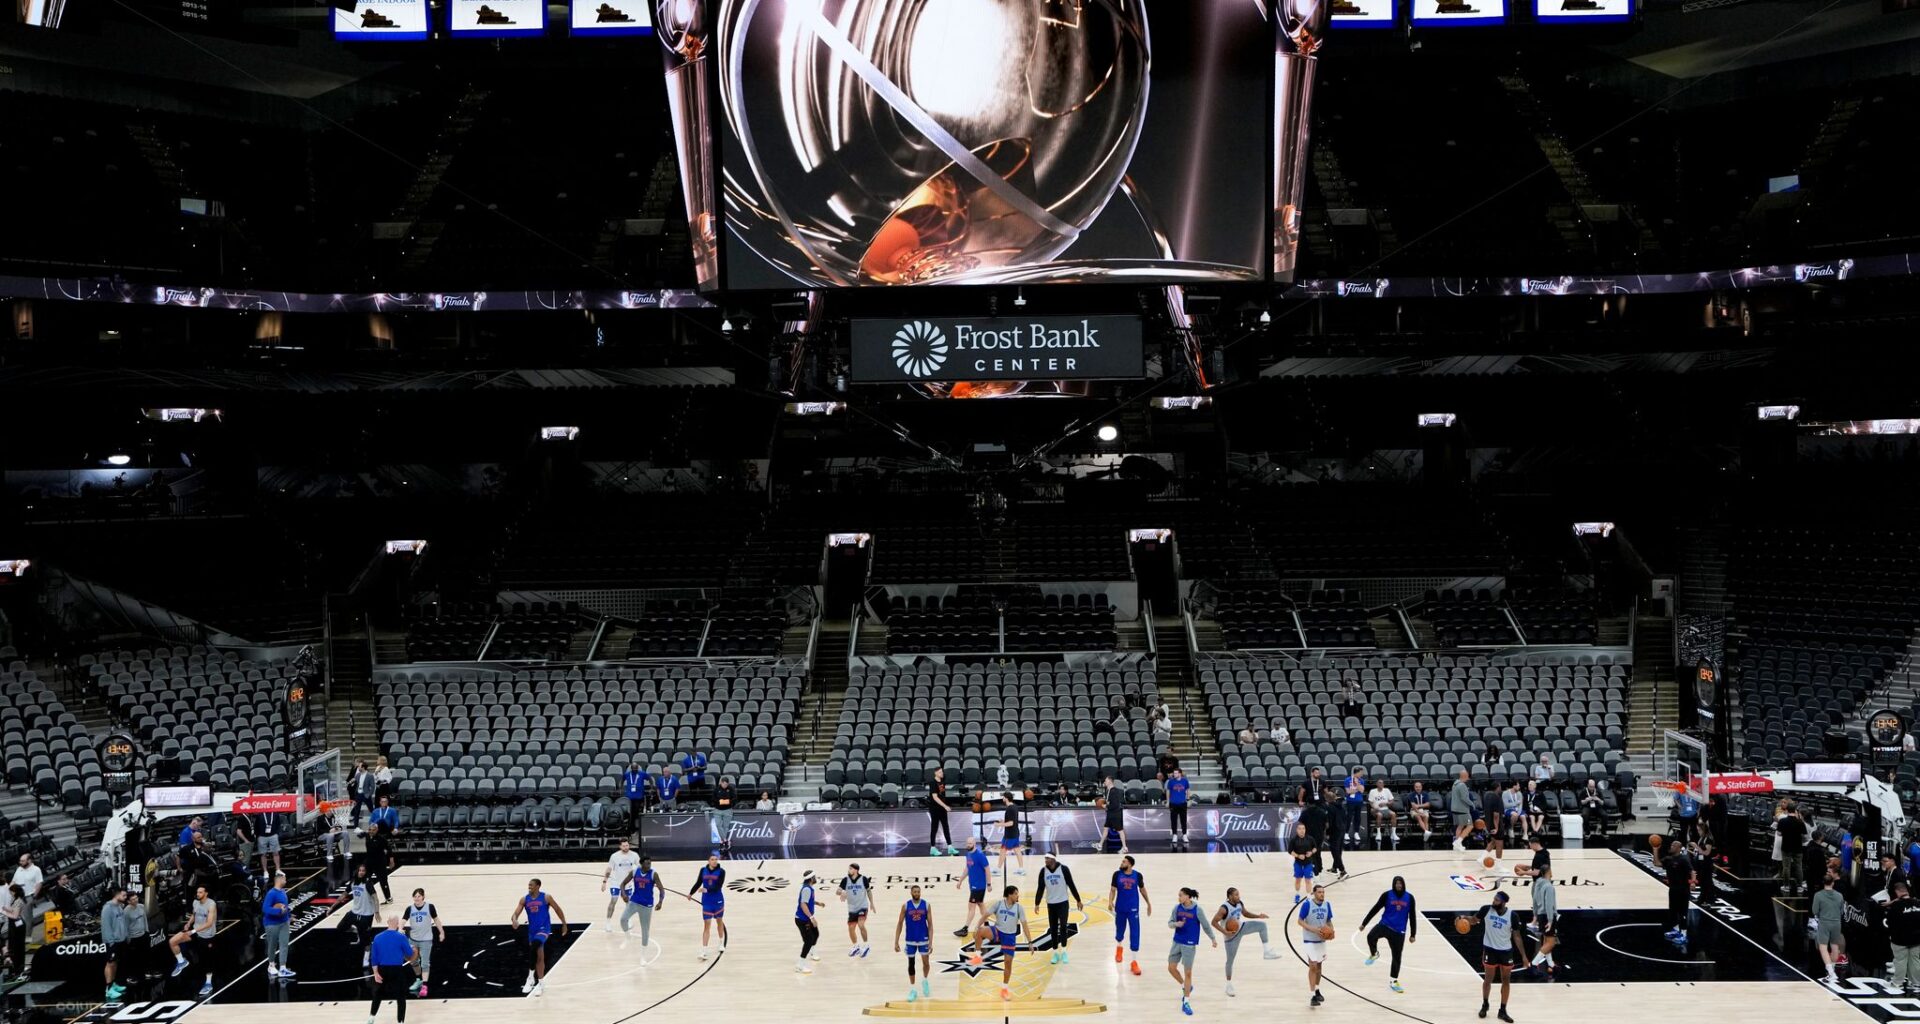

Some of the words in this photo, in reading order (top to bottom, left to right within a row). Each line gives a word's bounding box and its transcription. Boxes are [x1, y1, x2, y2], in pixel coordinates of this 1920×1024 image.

[1801, 264, 1834, 281] Finals
[1343, 283, 1372, 297] Finals
[1528, 280, 1556, 294] Finals
[165, 289, 196, 304] Finals
[629, 293, 657, 307] Finals
[441, 295, 470, 311] Finals
[955, 325, 1023, 350] Frost
[1029, 319, 1101, 349] Bank
[974, 358, 1076, 371] CENTER
[167, 410, 192, 421] Finals
[1764, 408, 1786, 419] Finals
[1879, 422, 1907, 433] Finals
[1136, 531, 1158, 542] Finals
[1000, 658, 1005, 667] 8
[1875, 719, 1898, 728] 13:42
[107, 744, 130, 754] 13:42
[1215, 813, 1271, 839] Finals
[727, 820, 775, 849] Finals
[1867, 841, 1877, 850] GET
[1867, 850, 1877, 859] THE
[129, 864, 140, 873] GET
[887, 873, 961, 883] Bank
[1846, 904, 1868, 927] Finals
[1492, 921, 1503, 929] 23
